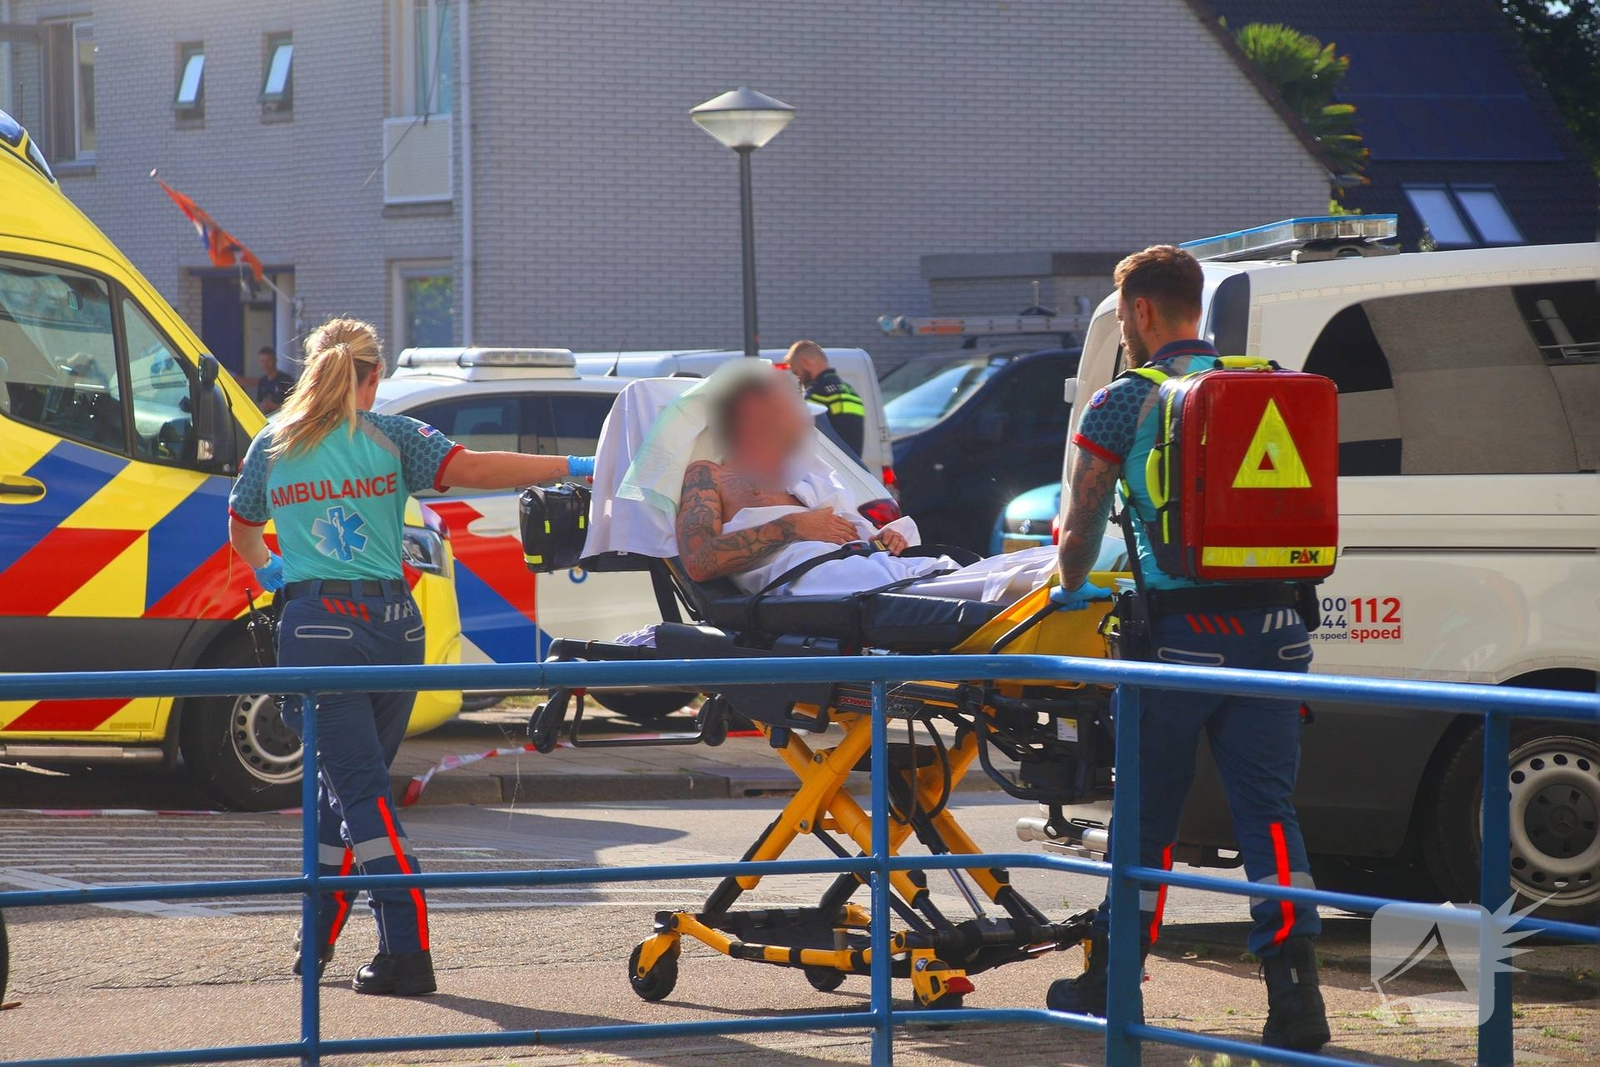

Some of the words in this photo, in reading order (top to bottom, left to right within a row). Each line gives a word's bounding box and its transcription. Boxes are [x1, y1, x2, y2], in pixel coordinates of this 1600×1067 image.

[271, 472, 397, 507] AMBULANCE
[1290, 549, 1320, 563] PAX
[1350, 597, 1401, 623] 112
[1320, 632, 1347, 641] spoed
[1350, 625, 1401, 643] spoed
